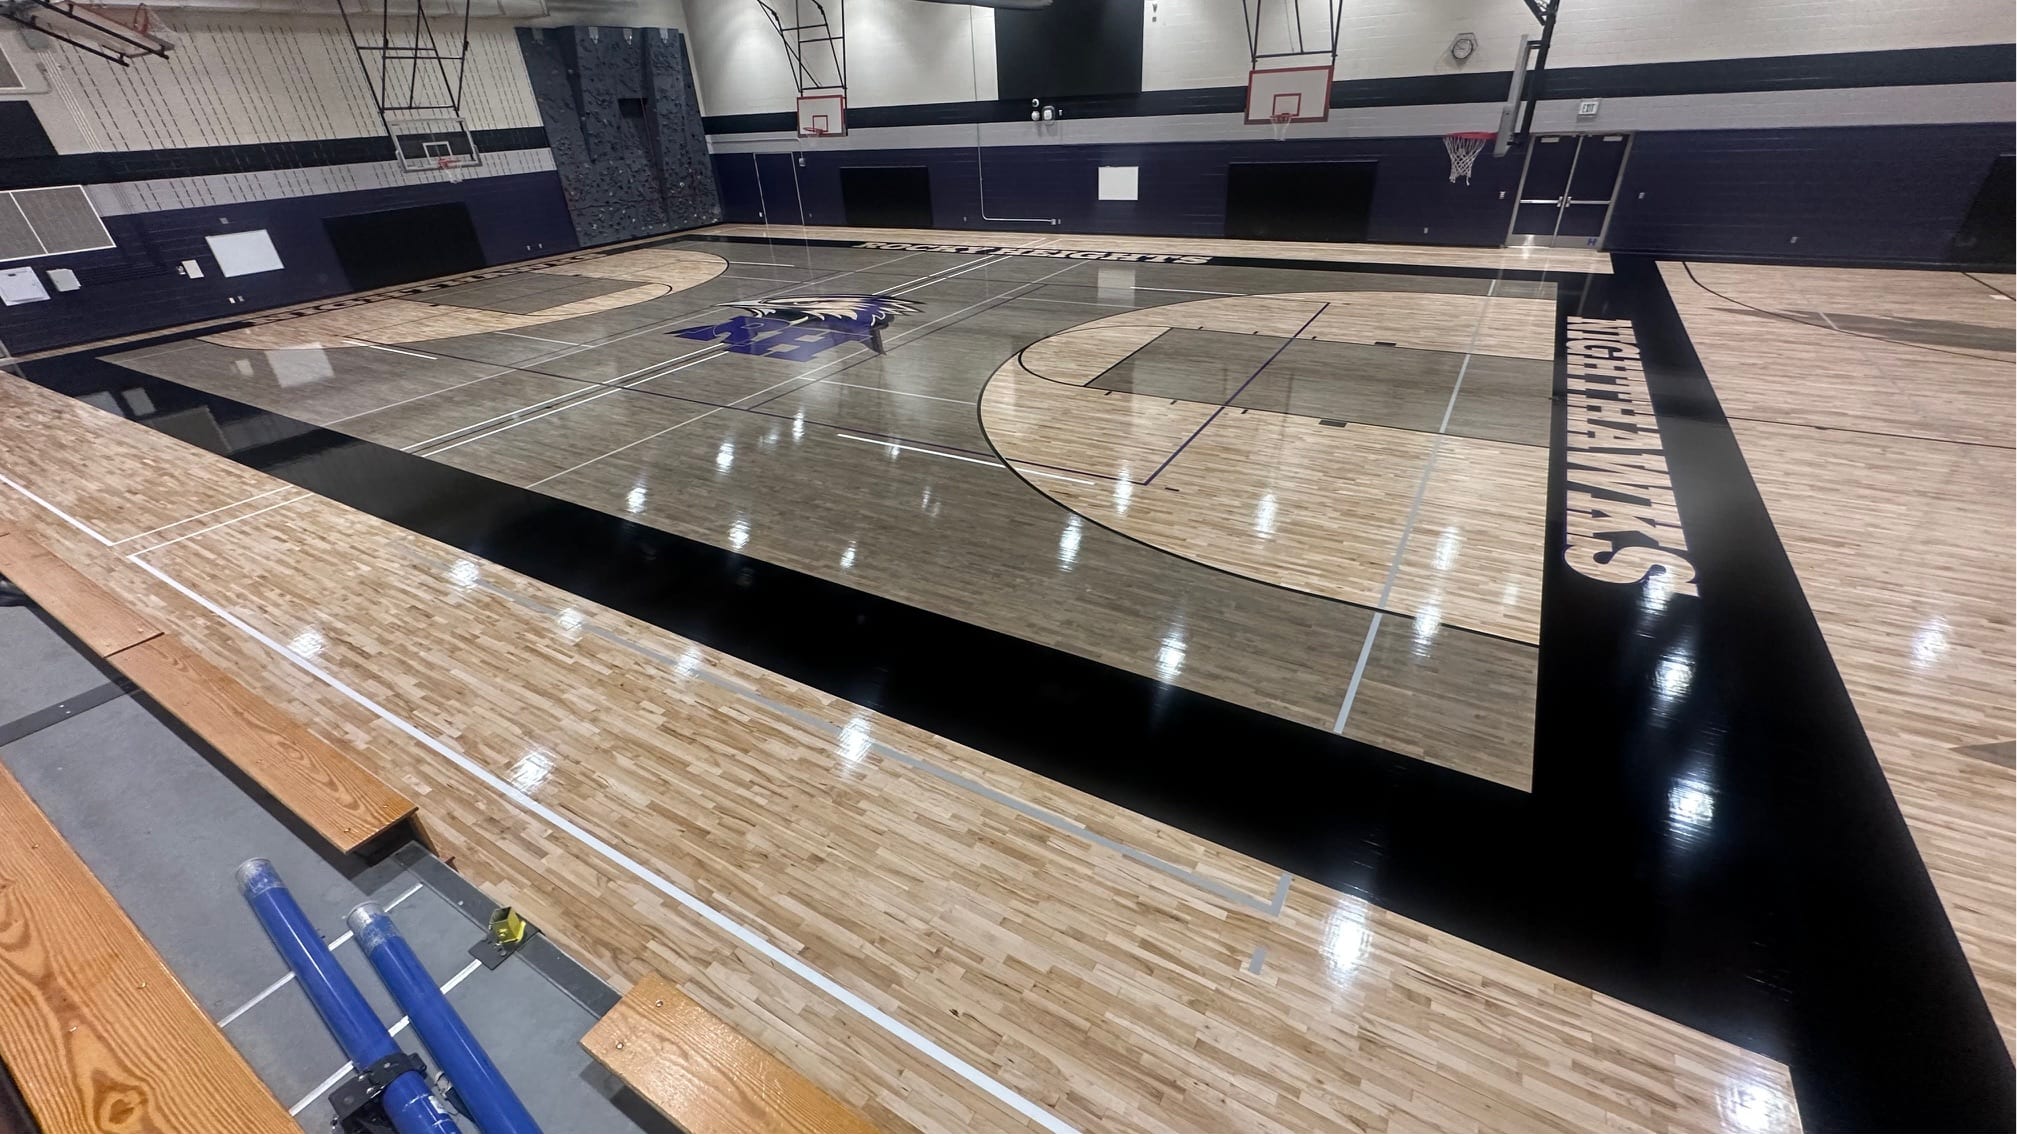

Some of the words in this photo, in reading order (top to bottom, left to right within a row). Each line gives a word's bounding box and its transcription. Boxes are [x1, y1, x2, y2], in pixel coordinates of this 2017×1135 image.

[851, 241, 995, 255] ROCKY
[988, 247, 1213, 265] HEIGHTS
[1564, 315, 1700, 598] NIGHTHAWKS
